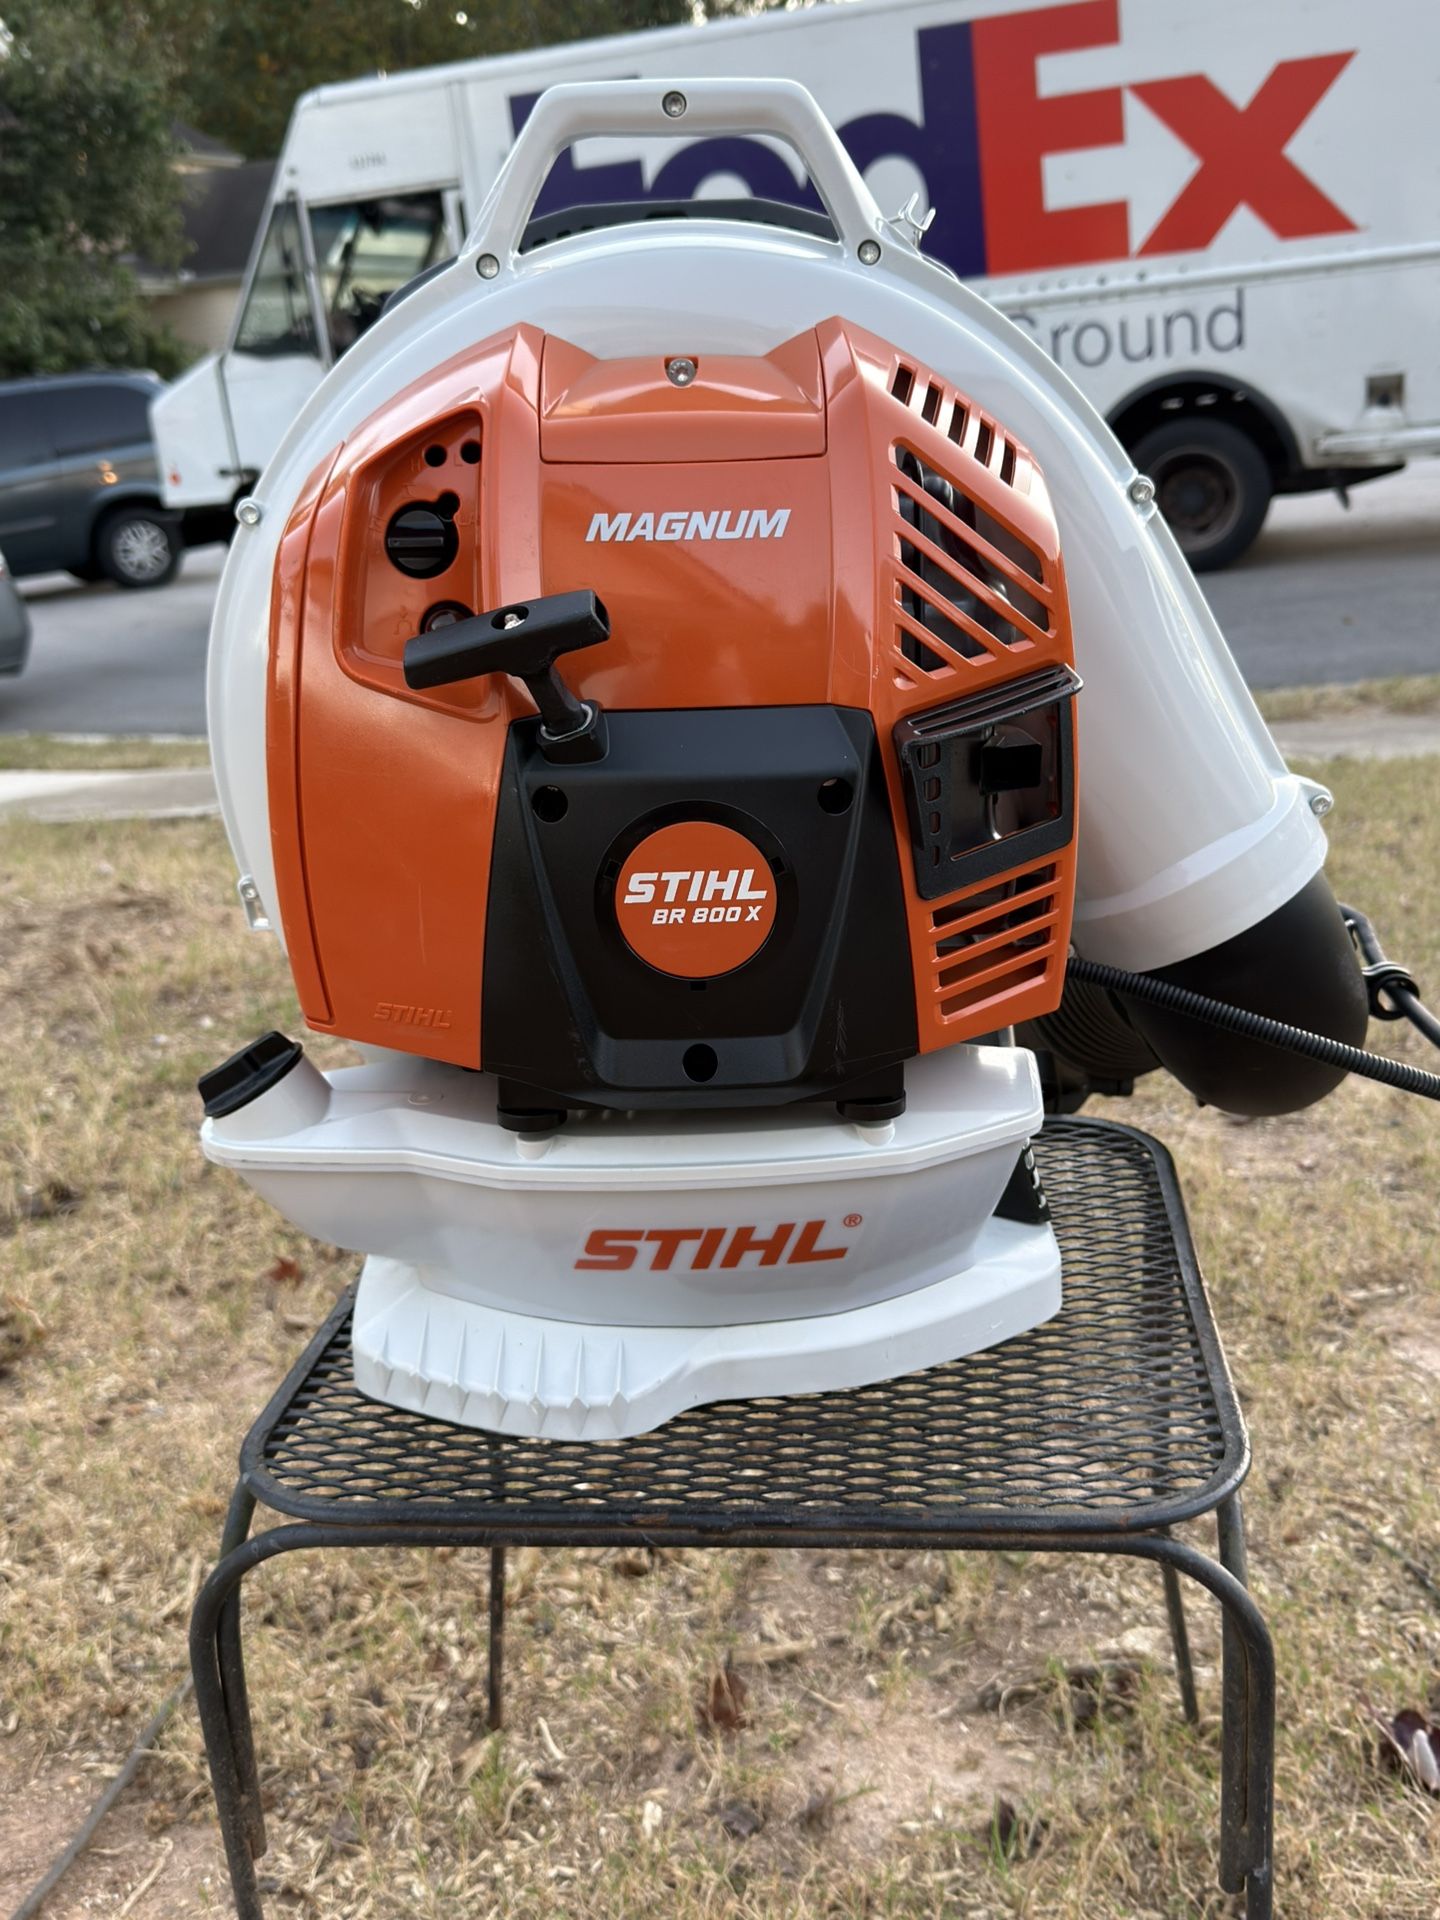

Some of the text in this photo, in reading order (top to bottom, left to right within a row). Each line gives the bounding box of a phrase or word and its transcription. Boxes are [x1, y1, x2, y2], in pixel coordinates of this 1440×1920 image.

[585, 509, 791, 542] MAGNUM
[623, 869, 767, 904] STIHL
[651, 905, 762, 925] BR 800 X
[373, 1001, 452, 1029] STIHL
